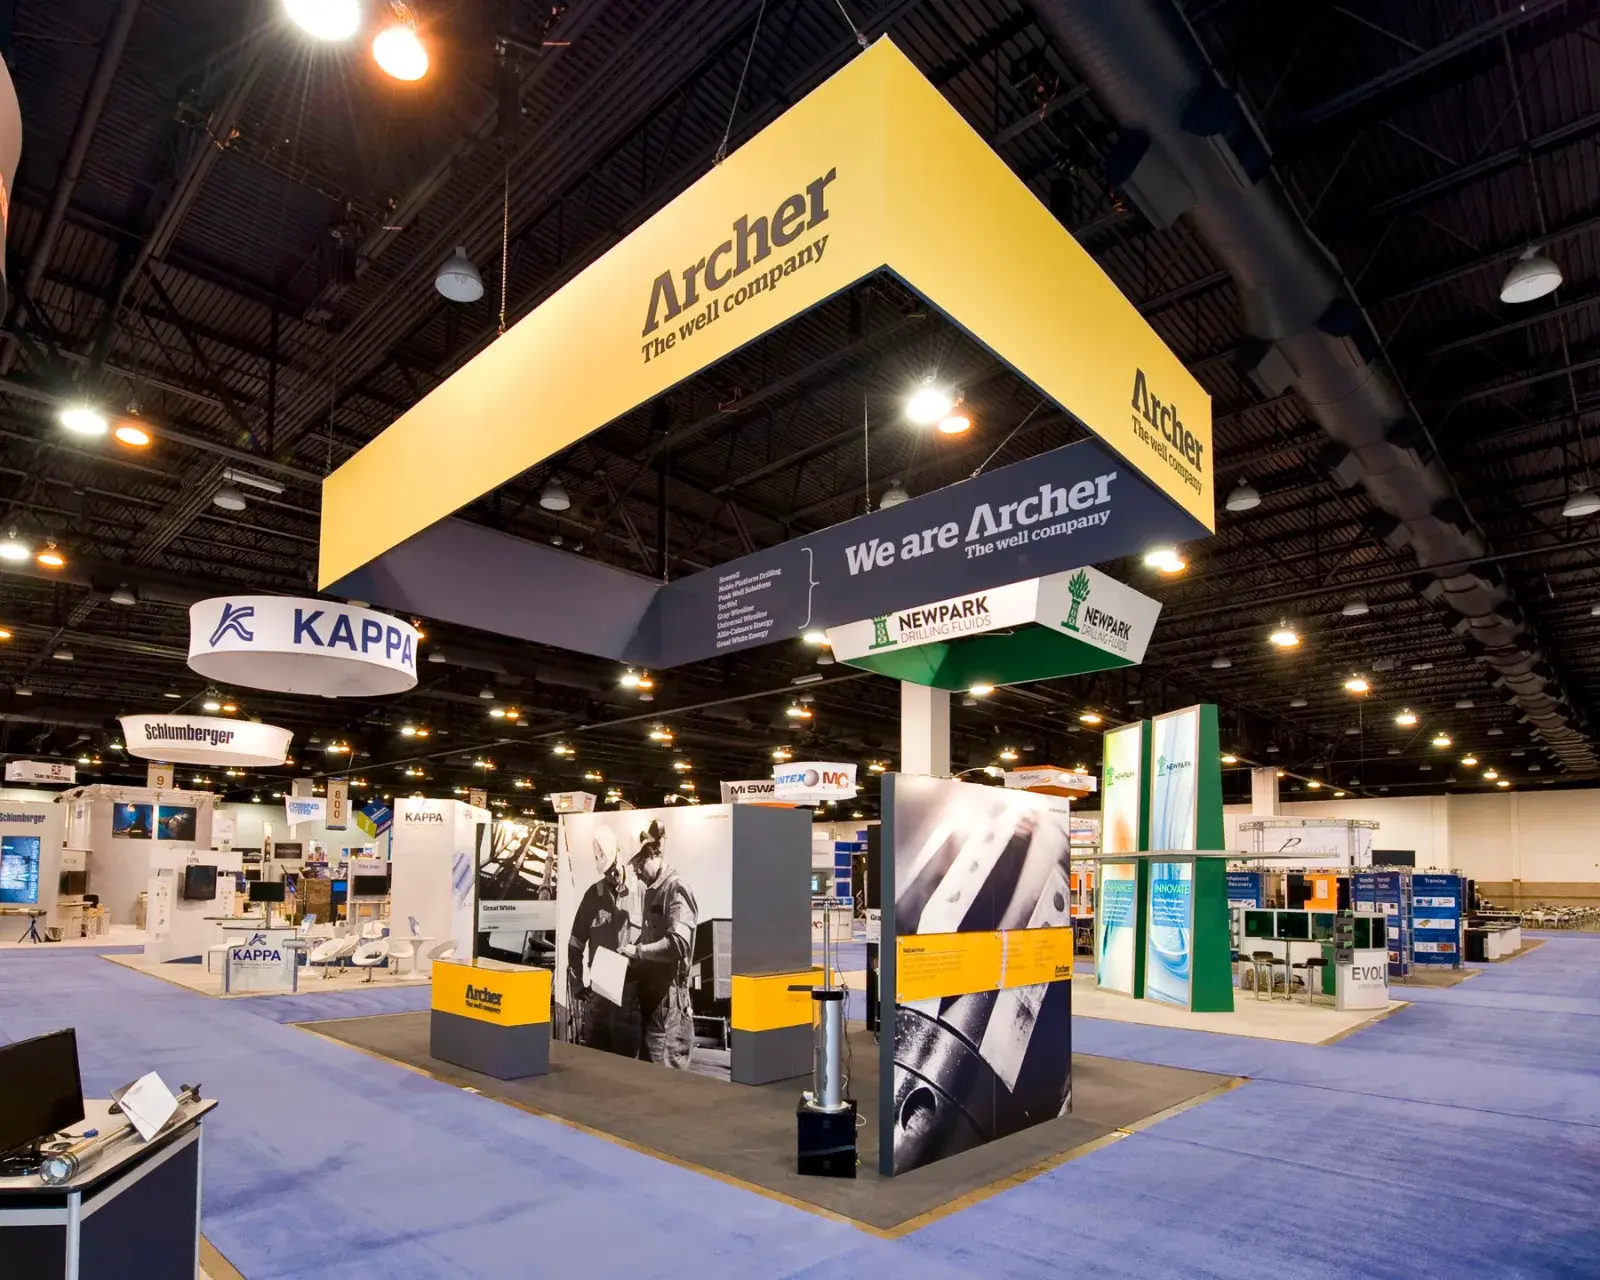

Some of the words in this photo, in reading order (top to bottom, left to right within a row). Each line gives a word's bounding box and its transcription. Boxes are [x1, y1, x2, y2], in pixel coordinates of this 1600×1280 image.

[642, 167, 836, 337] Archer
[642, 332, 676, 364] The
[679, 299, 719, 340] well
[724, 235, 829, 312] company
[1132, 367, 1203, 472] Archer
[1132, 415, 1150, 443] The
[1150, 435, 1168, 462] well
[1169, 453, 1202, 495] company
[845, 538, 895, 576] We
[901, 522, 960, 560] are
[965, 472, 1117, 542] Archer
[965, 542, 994, 559] The
[996, 529, 1029, 550] well
[1032, 510, 1111, 542] company
[718, 592, 731, 602] Peak
[732, 589, 744, 598] Well
[745, 581, 771, 594] Solutions
[719, 582, 734, 592] Noble
[735, 575, 759, 588] Platform
[759, 568, 781, 580] Drilling
[717, 611, 730, 620] Gray
[730, 605, 754, 616] Wireline
[717, 618, 743, 629] Universal
[744, 611, 767, 622] Wireline
[753, 619, 773, 630] Energy
[899, 596, 989, 632] NEWPARK
[1084, 606, 1132, 641] NEWPARK
[294, 608, 413, 668] KAPPA
[716, 639, 731, 648] Great
[732, 636, 748, 645] White
[749, 630, 769, 640] Energy
[900, 623, 950, 643] DRILLING
[951, 615, 991, 635] FLUIDS
[1081, 624, 1108, 647] DRILLING
[1107, 635, 1128, 652] FLUIDS
[145, 722, 234, 746] Schlumberger
[1166, 761, 1191, 771] NEWPARK
[0, 812, 46, 824] Schlumberger
[405, 812, 443, 822] KAPPA
[1155, 884, 1190, 894] INNOVATE
[233, 949, 281, 961] KAPPA
[465, 984, 502, 1006] Archer
